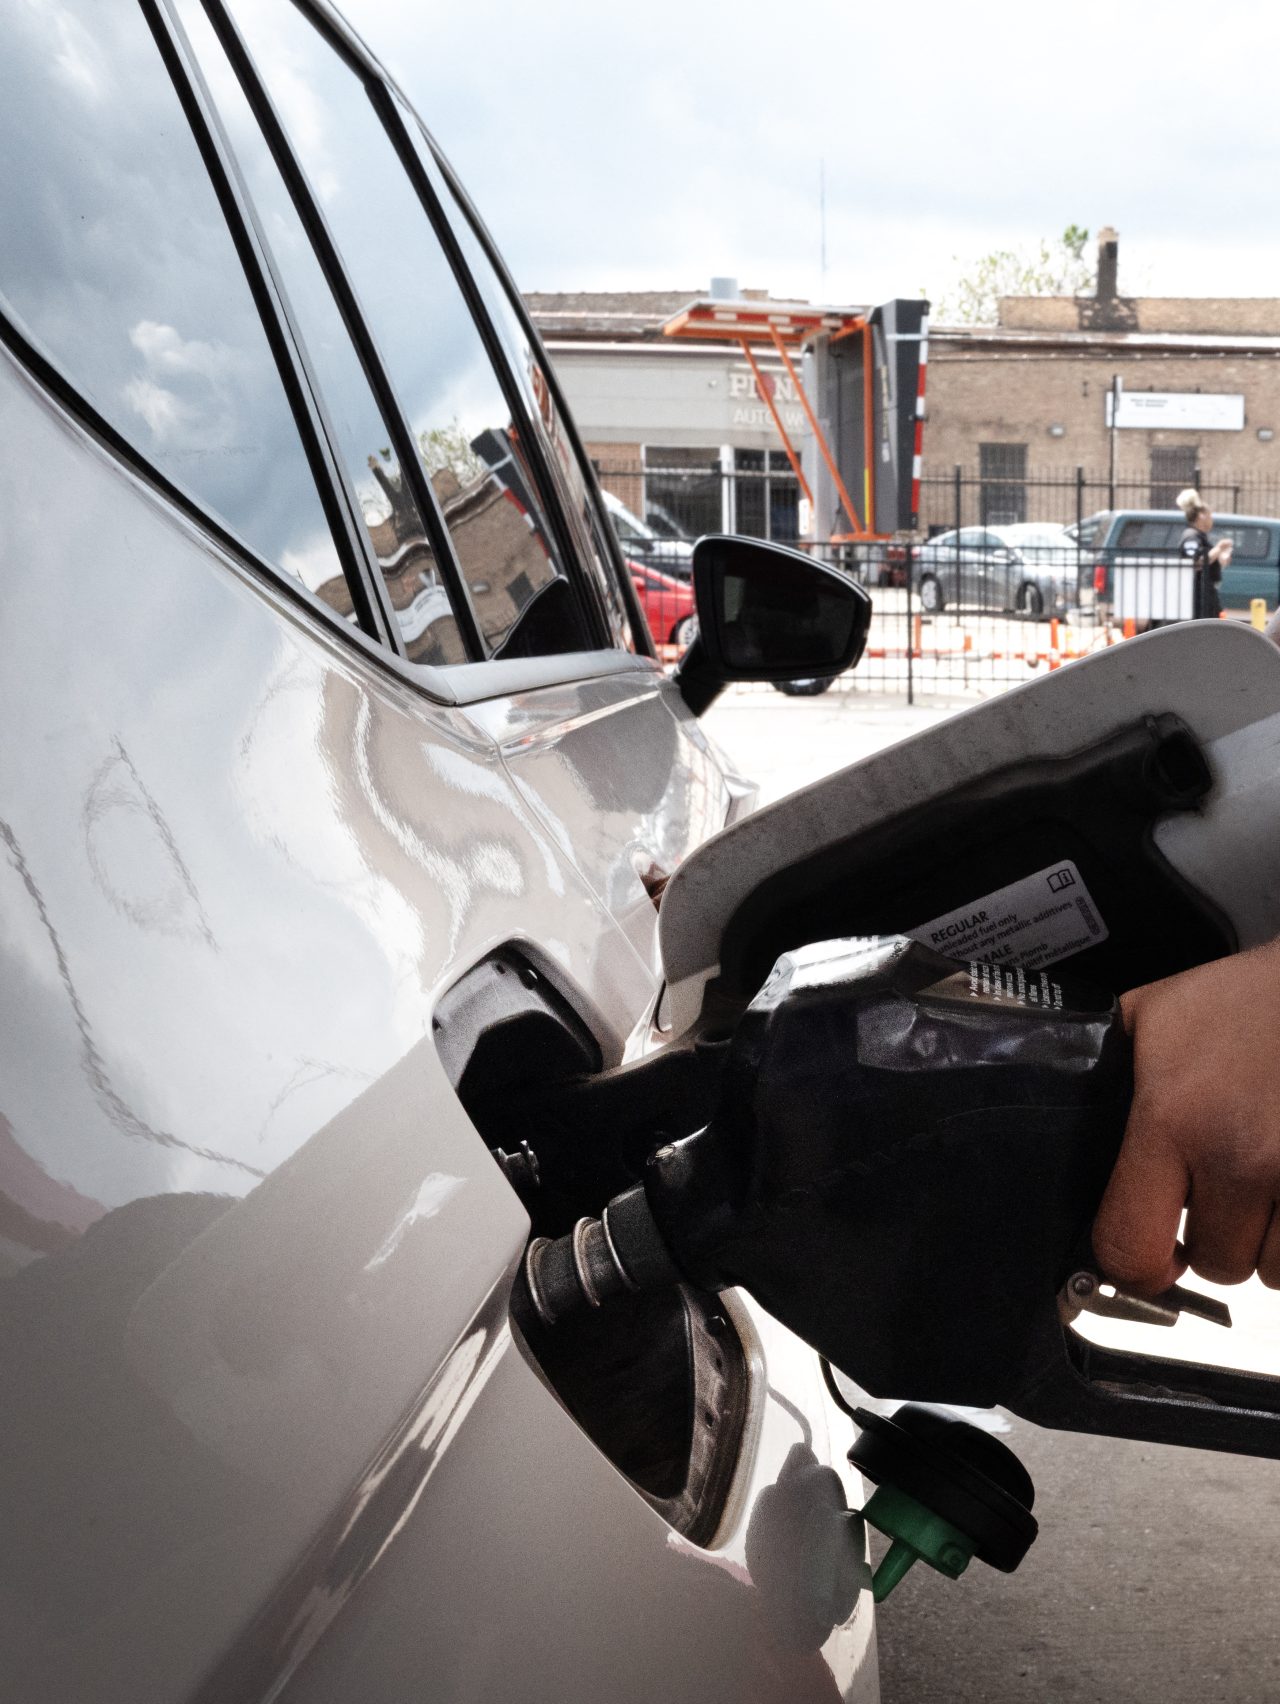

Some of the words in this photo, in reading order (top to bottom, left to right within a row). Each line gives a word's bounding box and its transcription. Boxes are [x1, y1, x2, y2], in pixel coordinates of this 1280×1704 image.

[932, 913, 988, 942] REGULAR
[938, 932, 978, 952] unleaded
[979, 922, 997, 934] fuel
[998, 914, 1019, 928] only
[981, 936, 996, 948] any
[996, 919, 1032, 938] metallic
[1033, 901, 1073, 921] additives
